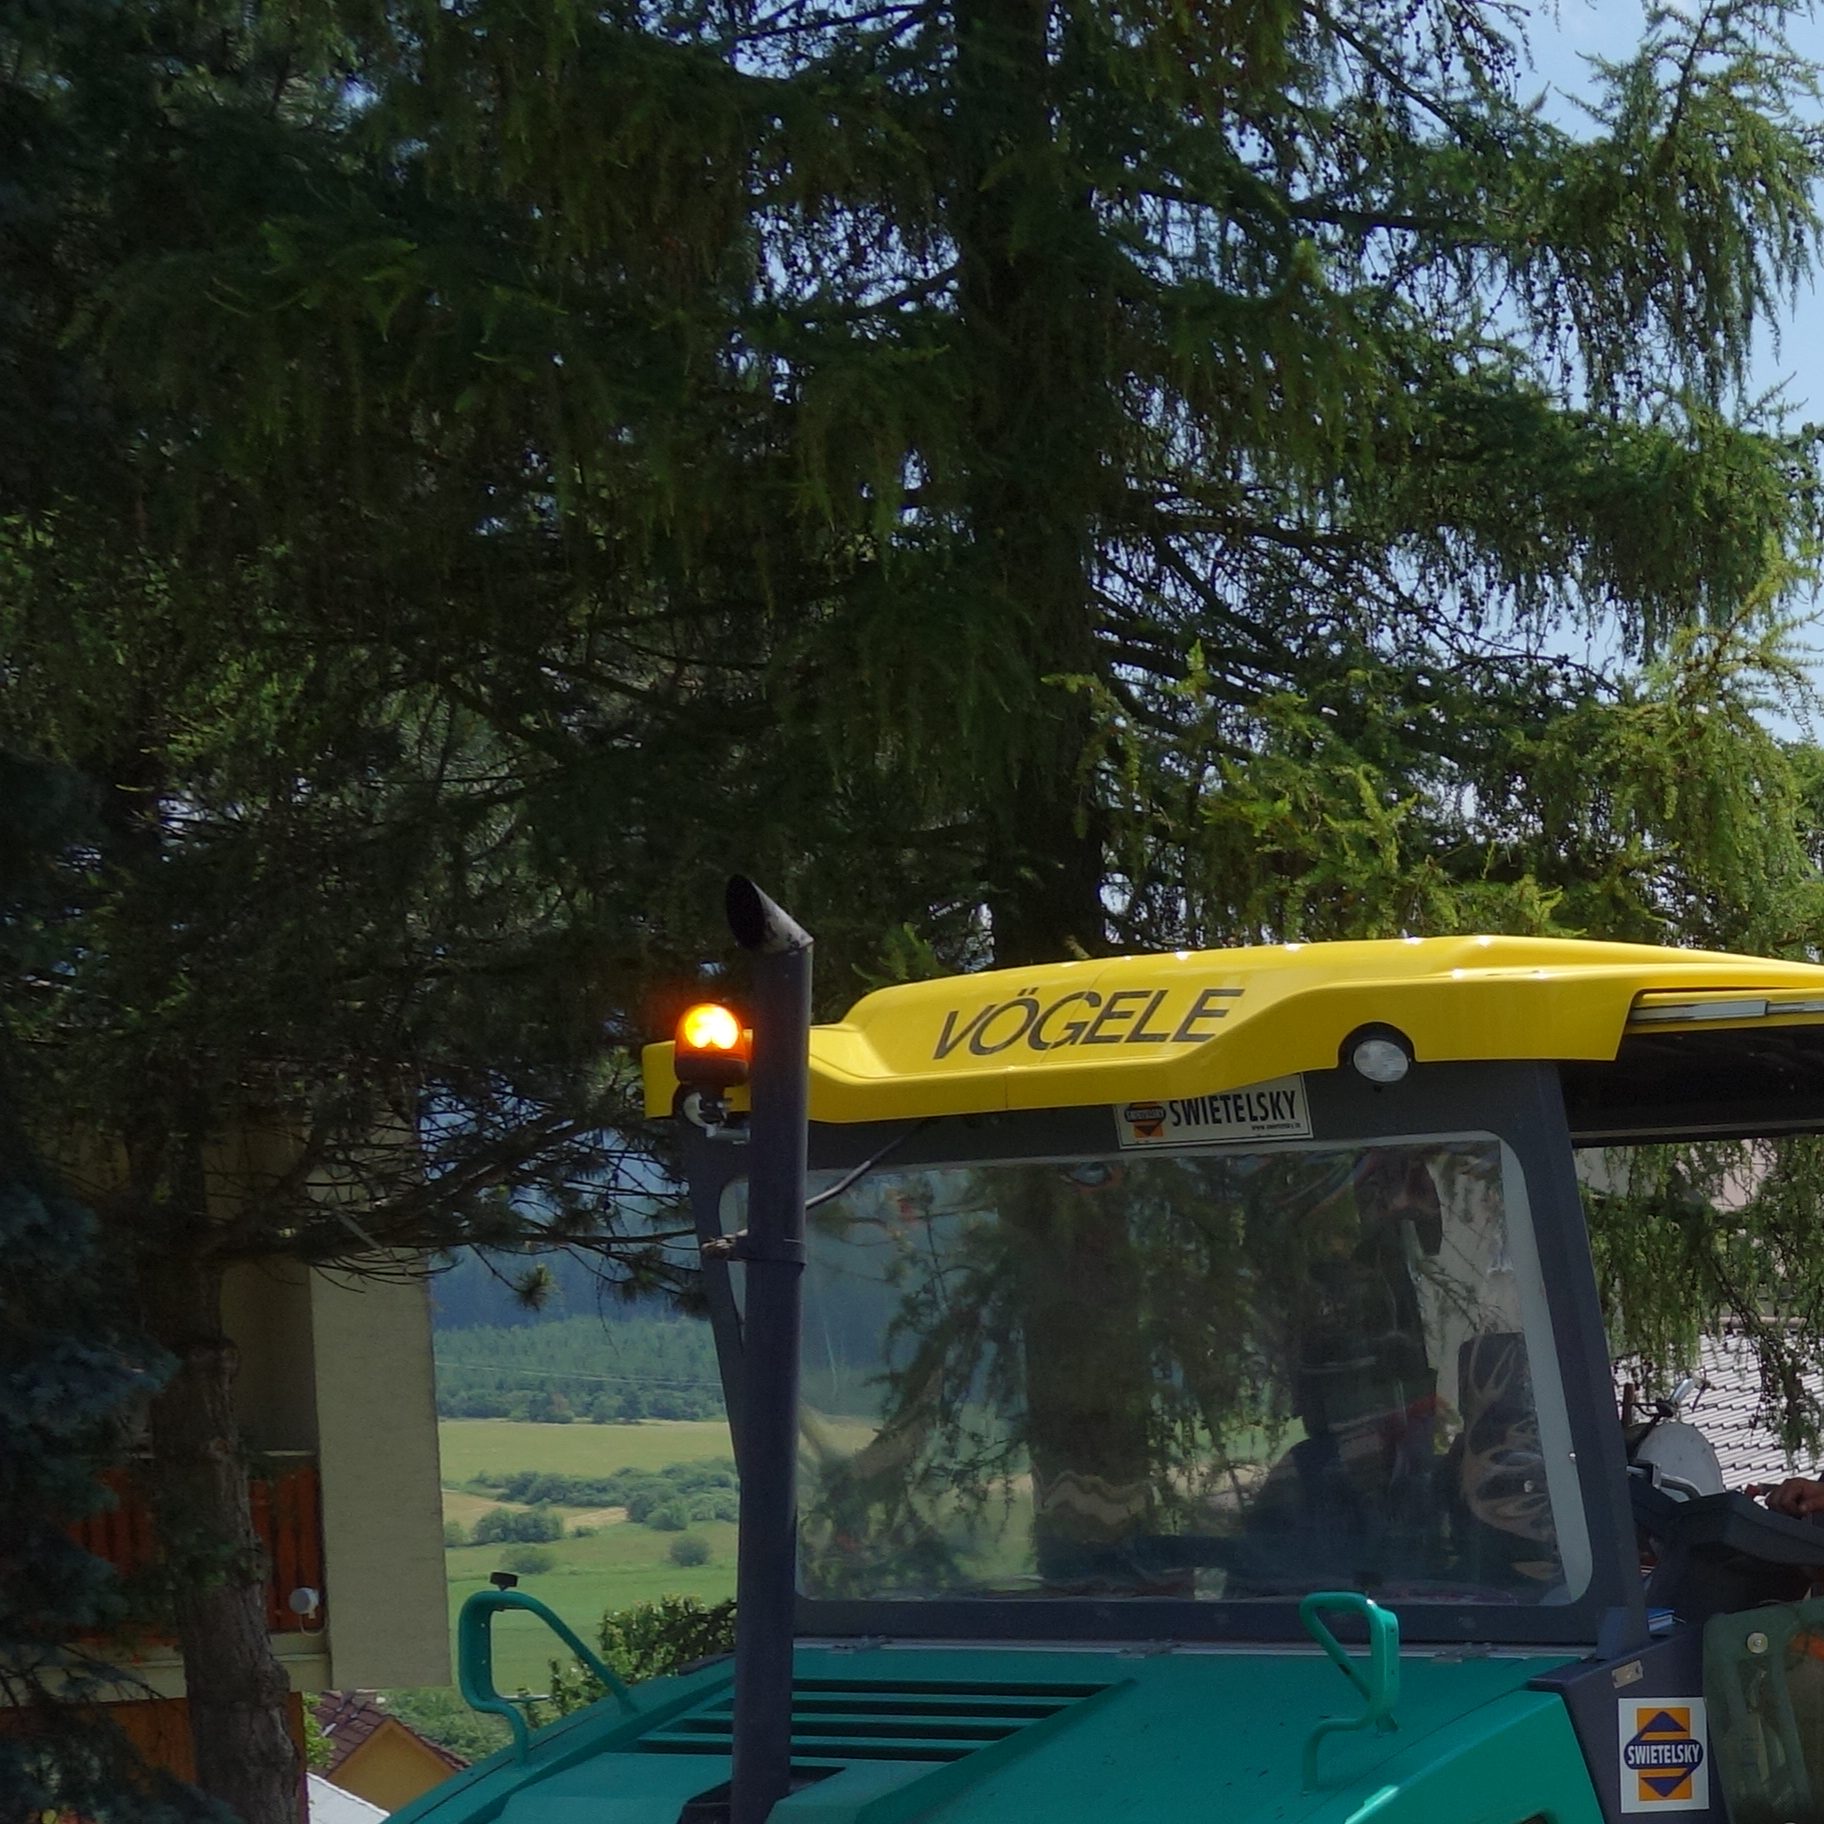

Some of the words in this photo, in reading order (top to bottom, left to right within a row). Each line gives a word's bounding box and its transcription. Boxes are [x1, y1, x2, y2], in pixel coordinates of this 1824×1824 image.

[932, 986, 1246, 1060] VÖGELE
[1169, 1090, 1297, 1127] SWIETELSKY
[1627, 1744, 1700, 1765] SWIETELSKY
